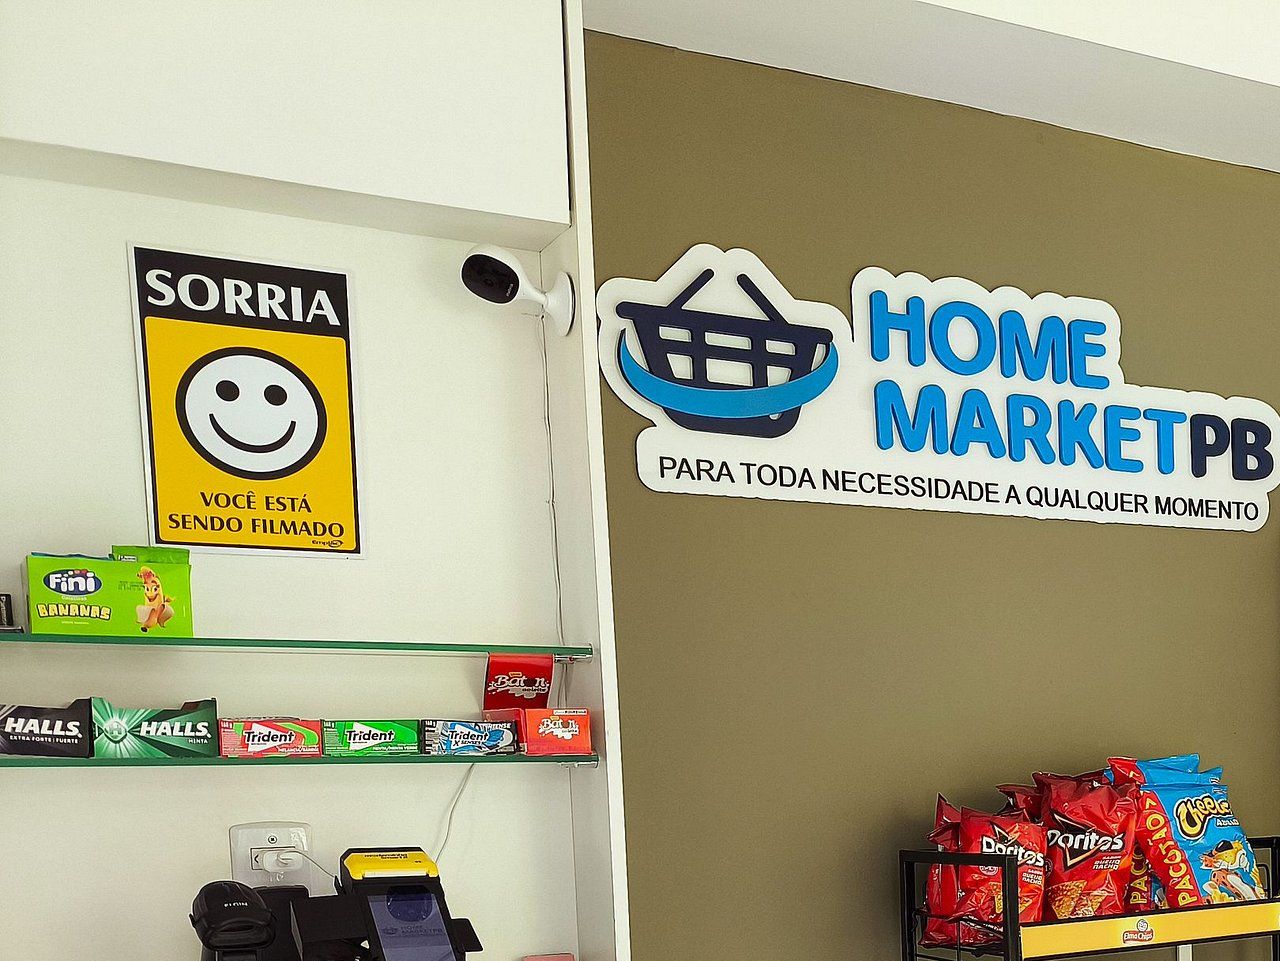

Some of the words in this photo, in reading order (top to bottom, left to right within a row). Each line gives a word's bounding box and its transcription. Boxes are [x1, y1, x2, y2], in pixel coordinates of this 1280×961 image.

[145, 269, 341, 326] SORRIA
[869, 290, 1109, 389] HOME
[874, 378, 1275, 482] MARKETPB
[658, 456, 735, 483] PARA
[740, 462, 817, 490] TODA
[822, 468, 1001, 504] NECESSIDADE
[1005, 484, 1020, 504] A
[1027, 485, 1150, 516] QUALQUER
[1154, 494, 1260, 523] MOMENTO
[200, 490, 256, 510] VOCÊ
[265, 494, 312, 513] ESTÁ
[168, 513, 243, 533] SENDO
[251, 518, 345, 538] FILMADO
[49, 570, 95, 592] Fini
[37, 603, 111, 620] BANANAS
[243, 730, 295, 743] Trident
[345, 730, 395, 742] Trident
[449, 731, 488, 742] Trident
[982, 836, 1045, 867] Doritos
[1047, 829, 1125, 851] Doritos
